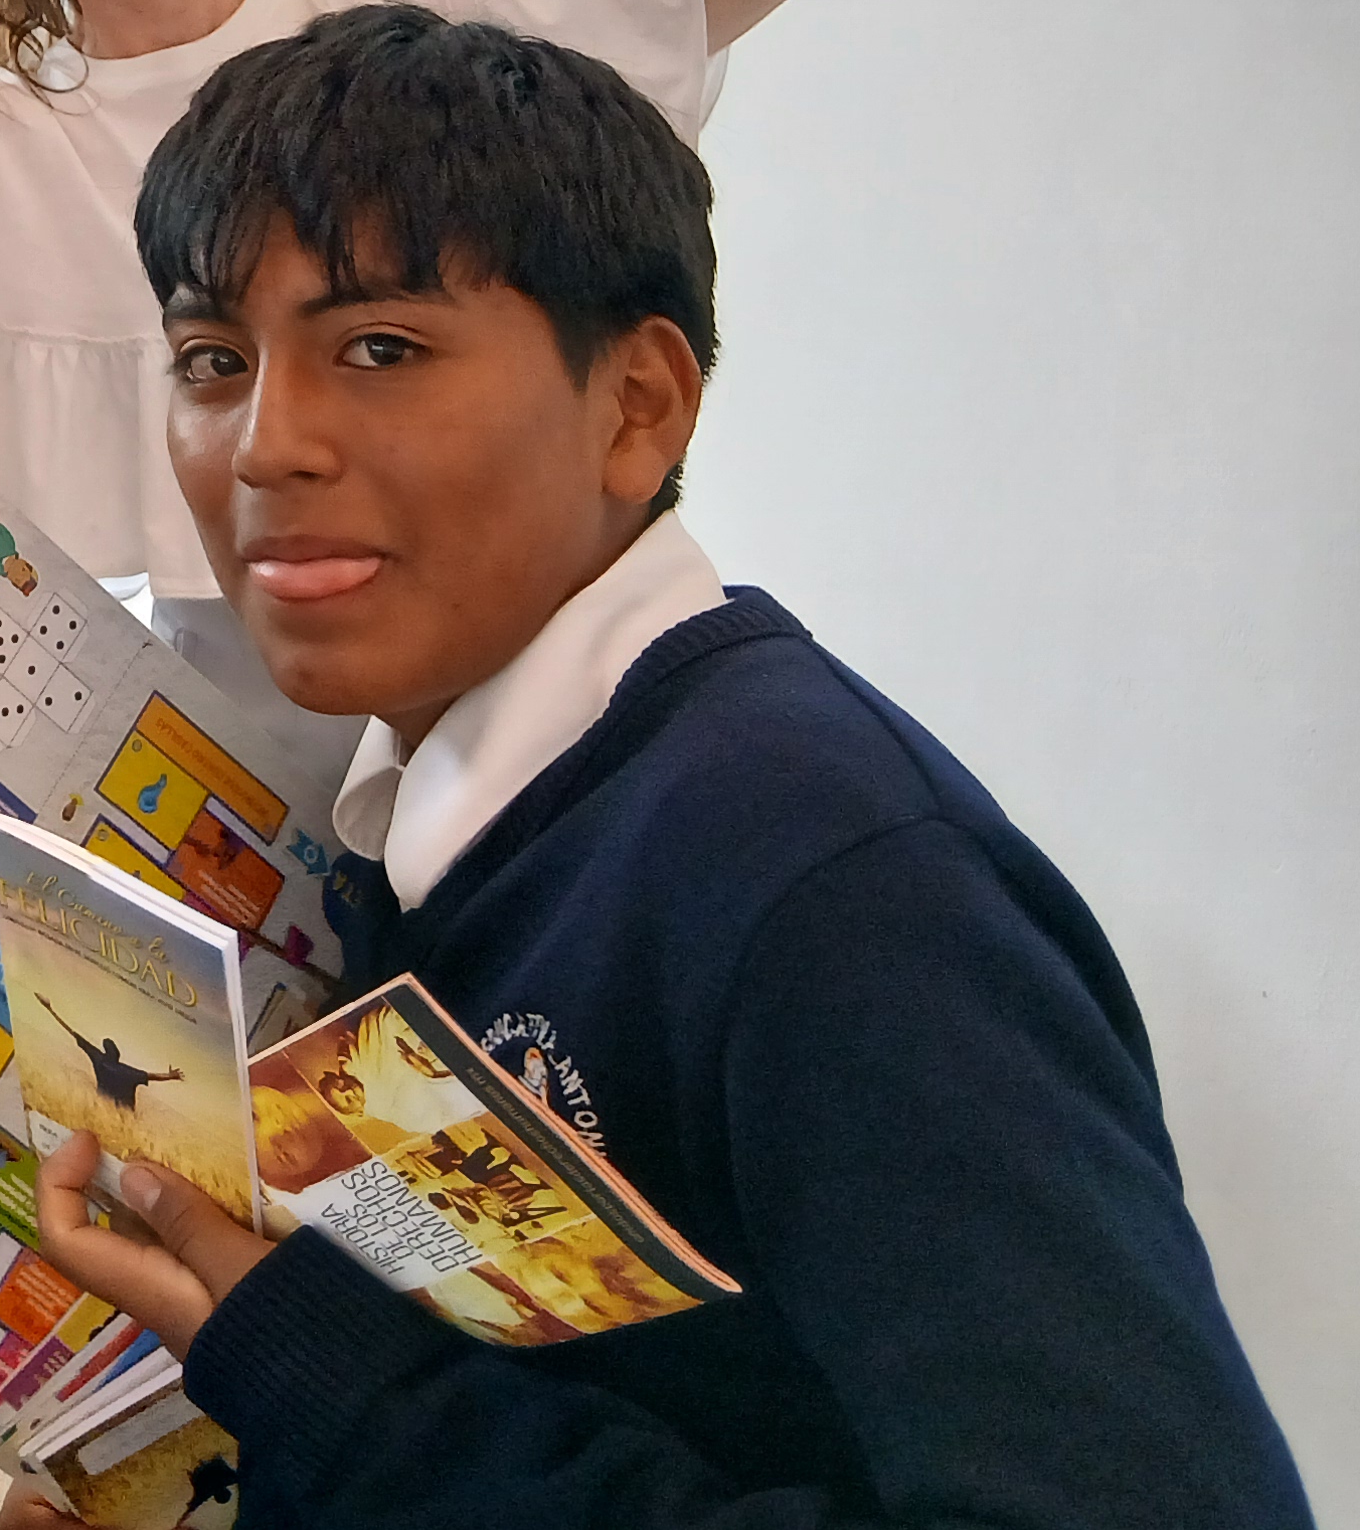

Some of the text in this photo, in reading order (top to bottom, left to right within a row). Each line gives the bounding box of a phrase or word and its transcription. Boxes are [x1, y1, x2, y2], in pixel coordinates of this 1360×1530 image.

[318, 1202, 404, 1274] HISTORIA
[337, 1170, 460, 1272] DERECHOS
[342, 1202, 415, 1260] DE LOS
[358, 1159, 483, 1263] HUMANOS
